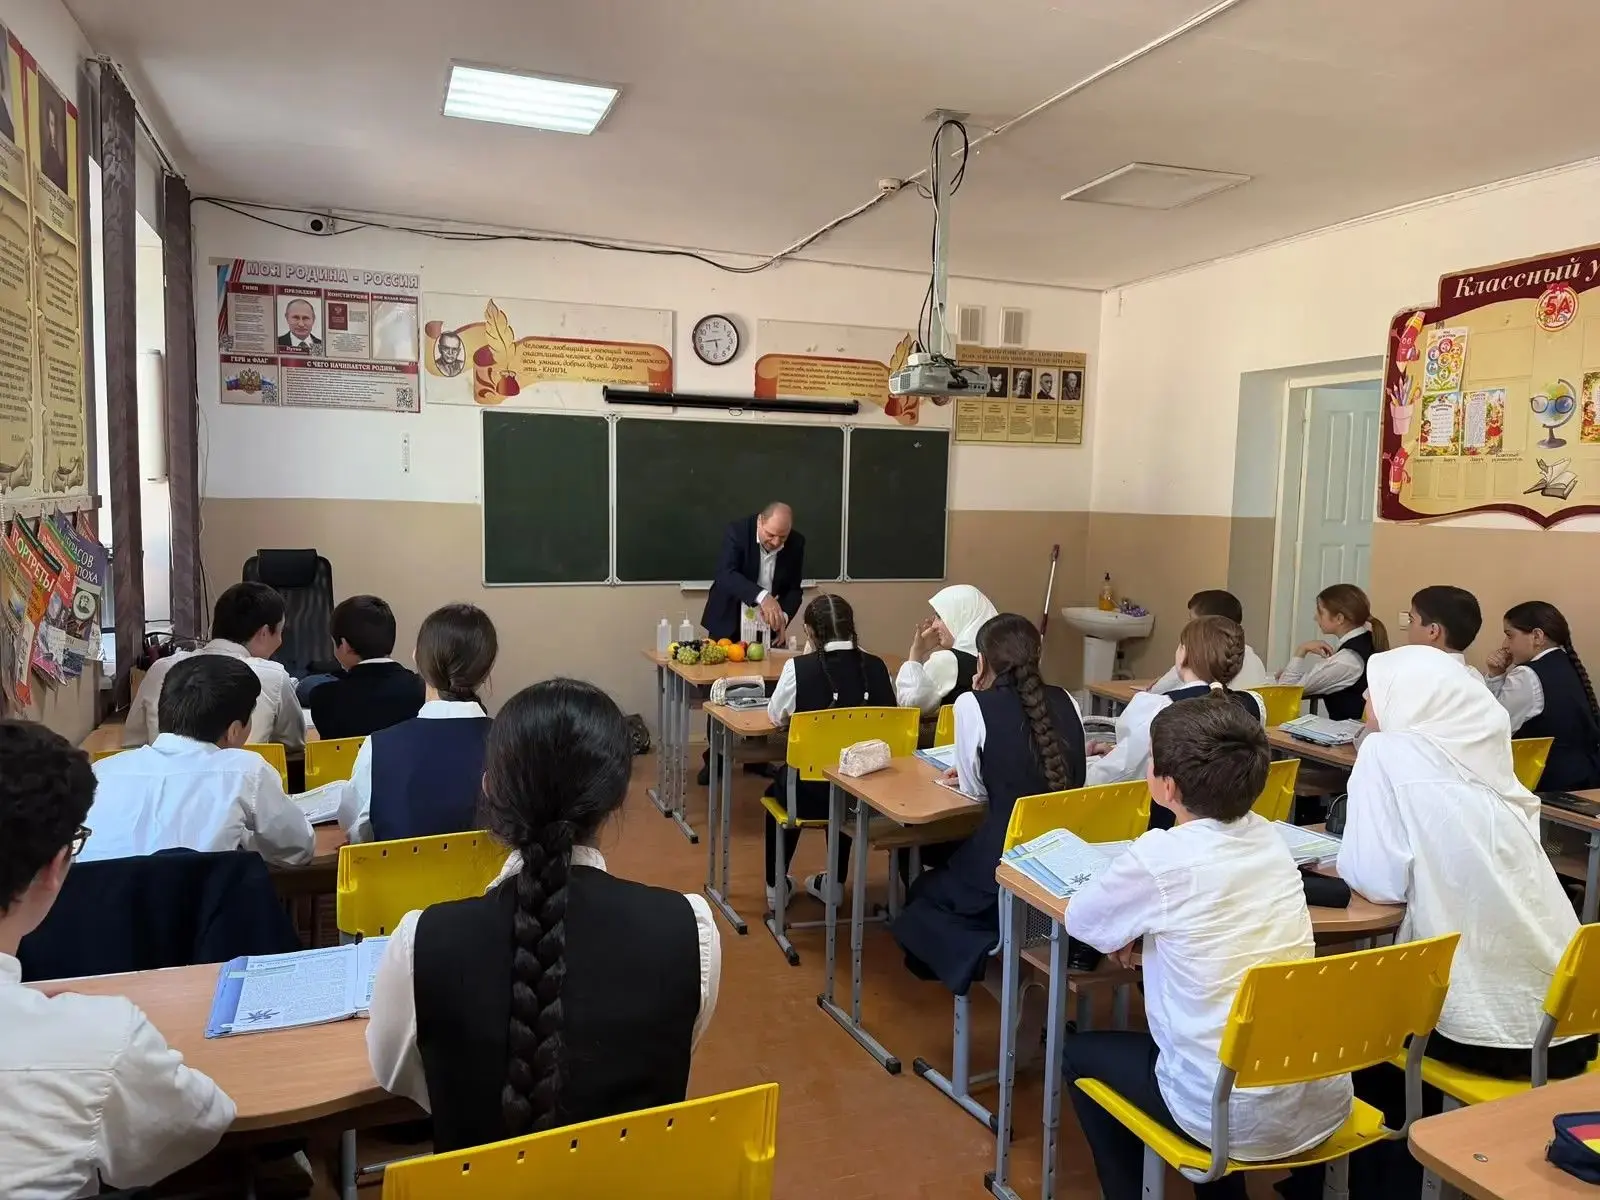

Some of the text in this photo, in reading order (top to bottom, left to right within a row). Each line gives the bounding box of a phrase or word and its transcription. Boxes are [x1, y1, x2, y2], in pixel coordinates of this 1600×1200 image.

[246, 261, 281, 278] МОЯ
[286, 264, 349, 284] РОДИНА
[363, 271, 419, 289] РОССИЯ
[1453, 257, 1581, 299] Классный
[284, 288, 317, 296] ПРЕЗИДЕНТ
[327, 291, 368, 300] КОНСТИТУЦИЯ
[330, 361, 371, 371] НАЧИНАЕТСЯ
[13, 527, 55, 592] ПОРТРЕТЫ
